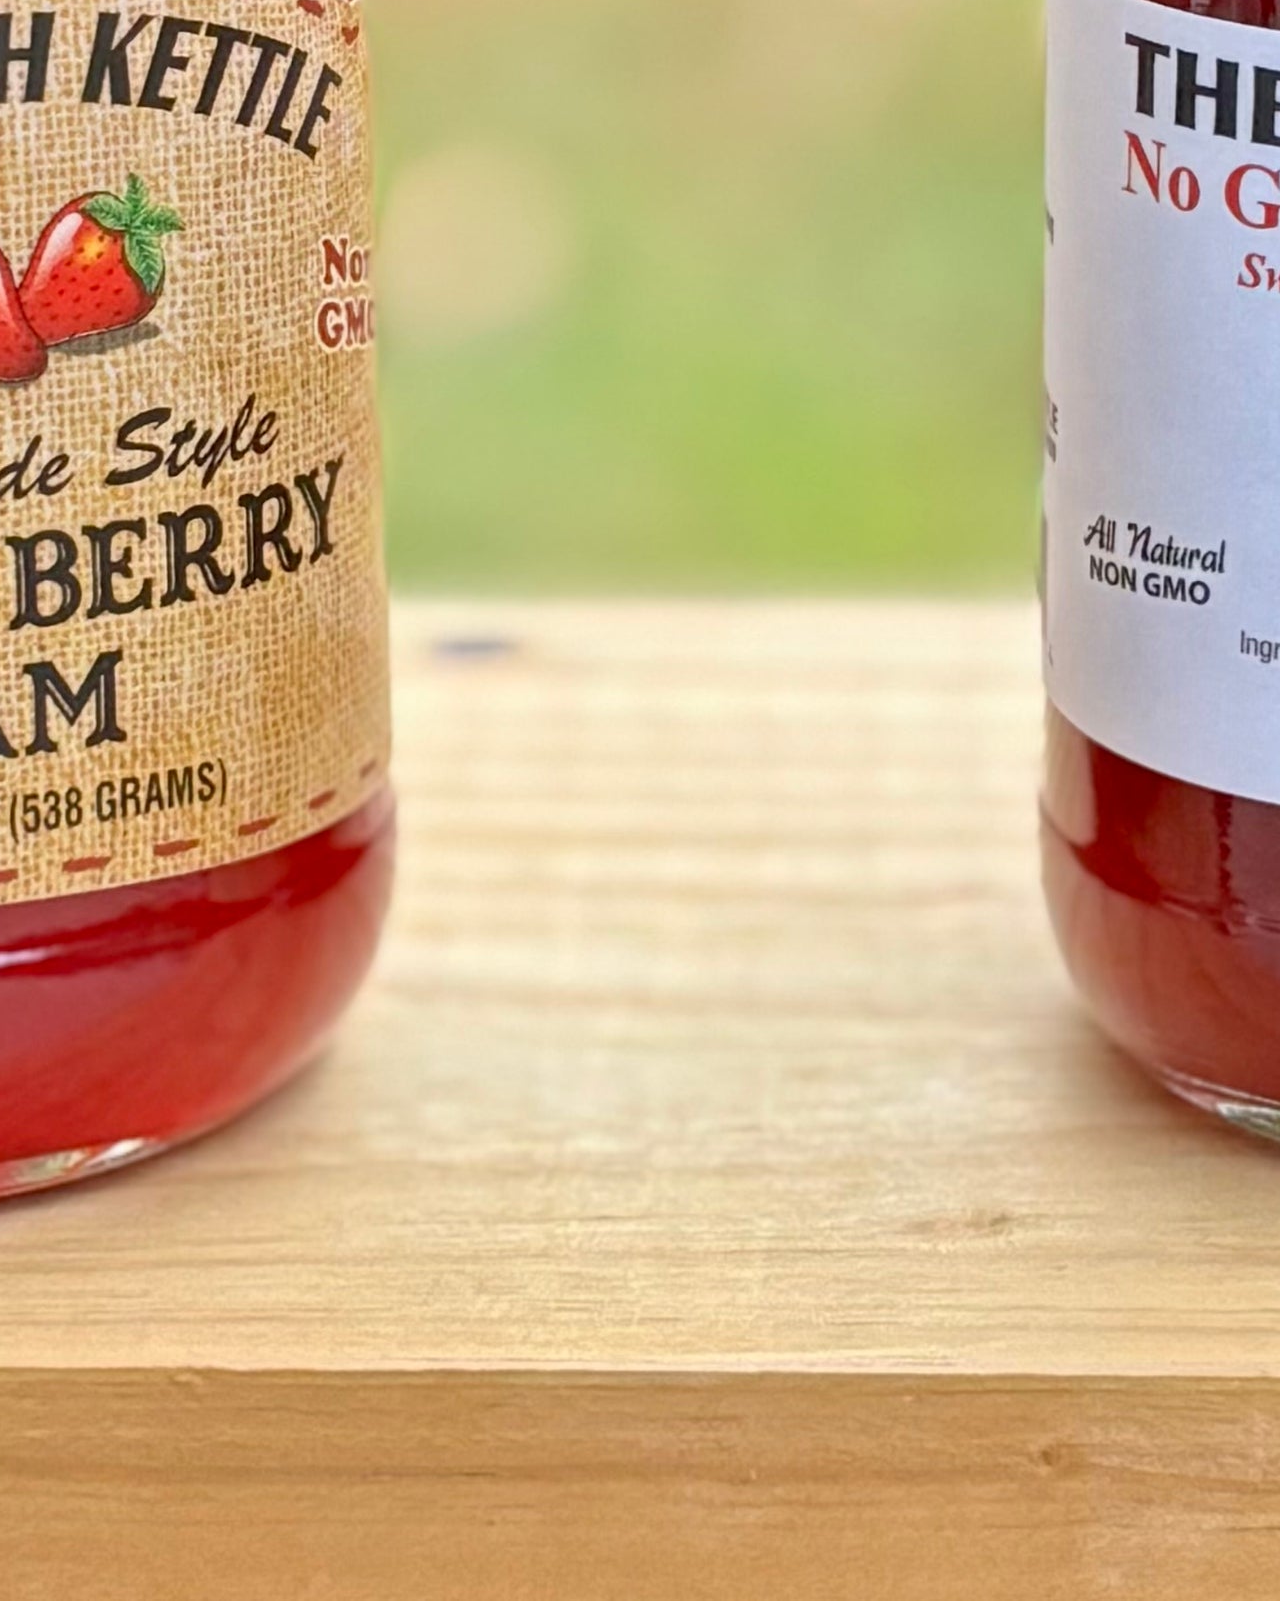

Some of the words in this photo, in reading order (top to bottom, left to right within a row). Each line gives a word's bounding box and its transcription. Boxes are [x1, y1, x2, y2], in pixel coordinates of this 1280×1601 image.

[81, 11, 344, 162] KETTLE
[1121, 130, 1201, 213] No
[322, 237, 371, 285] No
[105, 395, 279, 489] Style
[1084, 514, 1116, 553] All
[1127, 522, 1226, 574] Natural
[1090, 554, 1137, 592] NON
[1143, 572, 1211, 606] GMO
[9, 785, 83, 845] (538
[95, 758, 228, 823] GRAMS)
